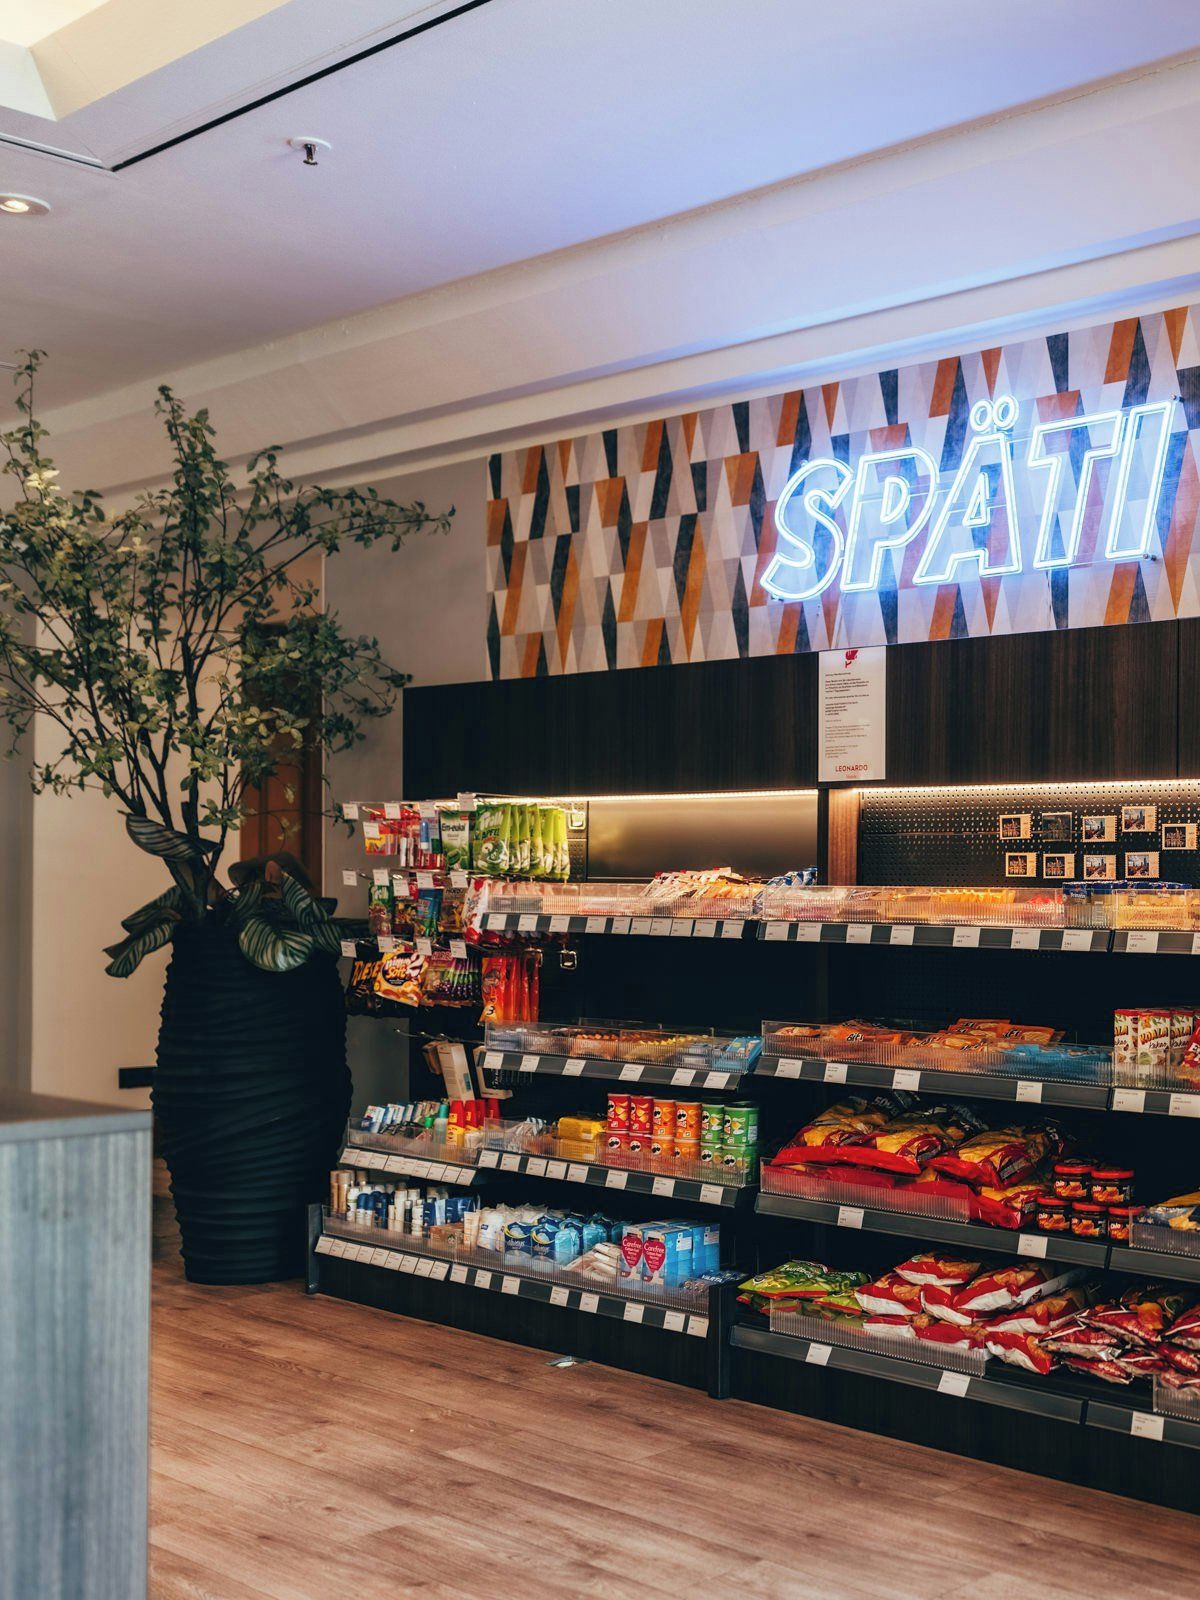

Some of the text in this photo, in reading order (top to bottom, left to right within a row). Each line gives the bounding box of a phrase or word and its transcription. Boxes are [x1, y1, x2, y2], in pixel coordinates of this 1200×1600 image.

[760, 395, 1174, 600] SPÄTI
[835, 763, 868, 773] LEONARDO
[441, 823, 466, 832] Em-eukal
[1140, 1026, 1168, 1045] KOALA
[644, 1243, 664, 1254] Carefree
